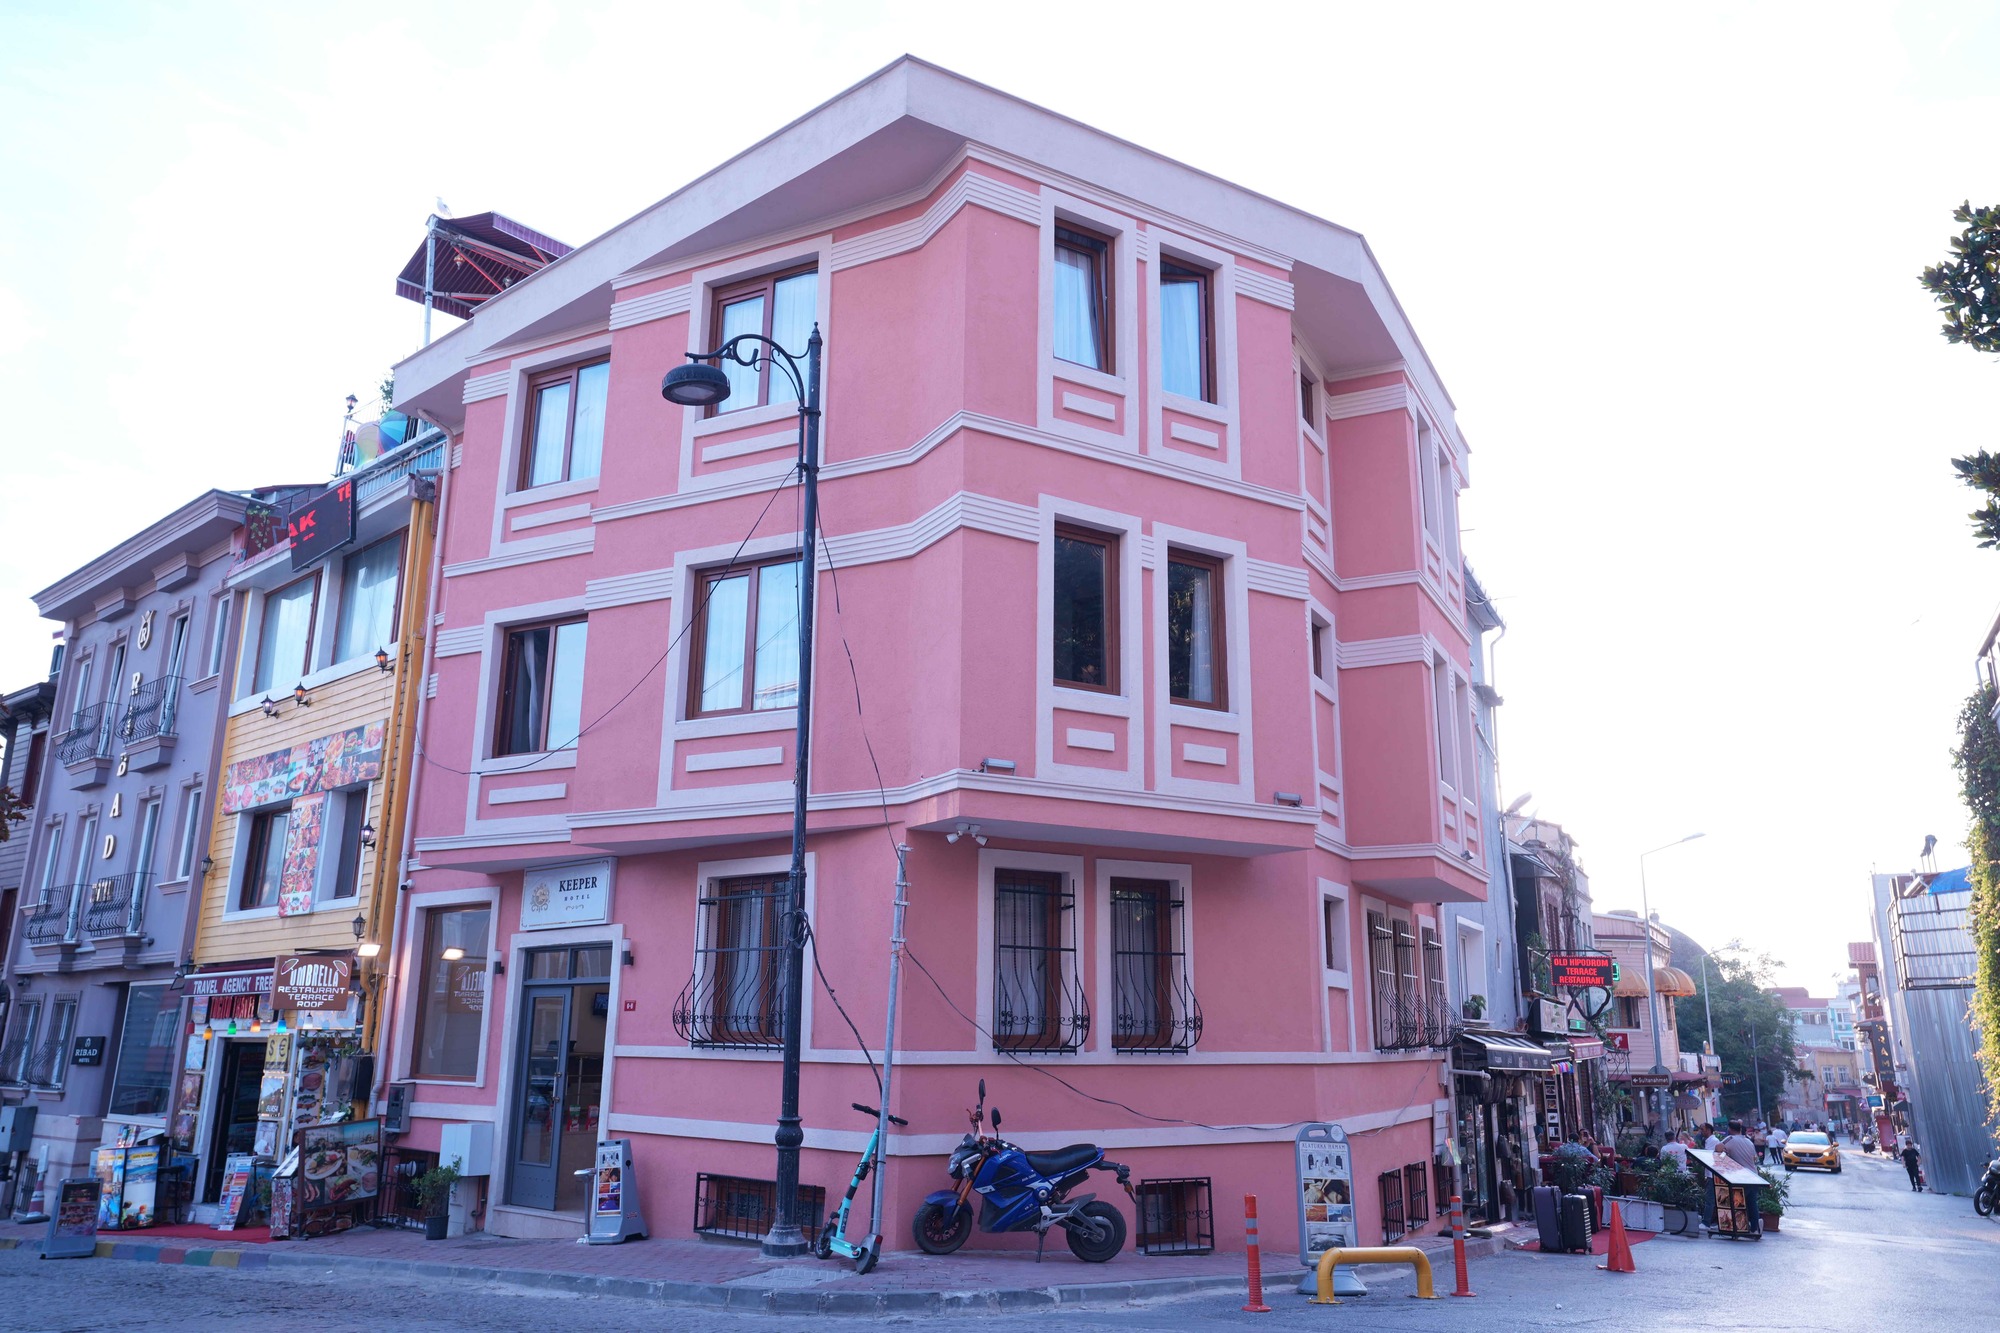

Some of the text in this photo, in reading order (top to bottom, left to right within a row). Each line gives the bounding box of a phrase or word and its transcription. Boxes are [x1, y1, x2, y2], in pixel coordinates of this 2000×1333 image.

[559, 876, 598, 892] KEEPER
[1554, 958, 1609, 967] OLD HIPODROM
[290, 963, 339, 987] UMBRELLA
[1566, 967, 1598, 976] TERRACE
[1559, 976, 1605, 985] RESTAURANT
[193, 979, 218, 995] TRAVEL
[222, 977, 251, 993] AGENCY
[277, 986, 346, 994] RESTAURANT
[288, 993, 334, 1001] TERRACE
[296, 1000, 324, 1008] ROOF
[75, 1048, 98, 1057] RIBAD
